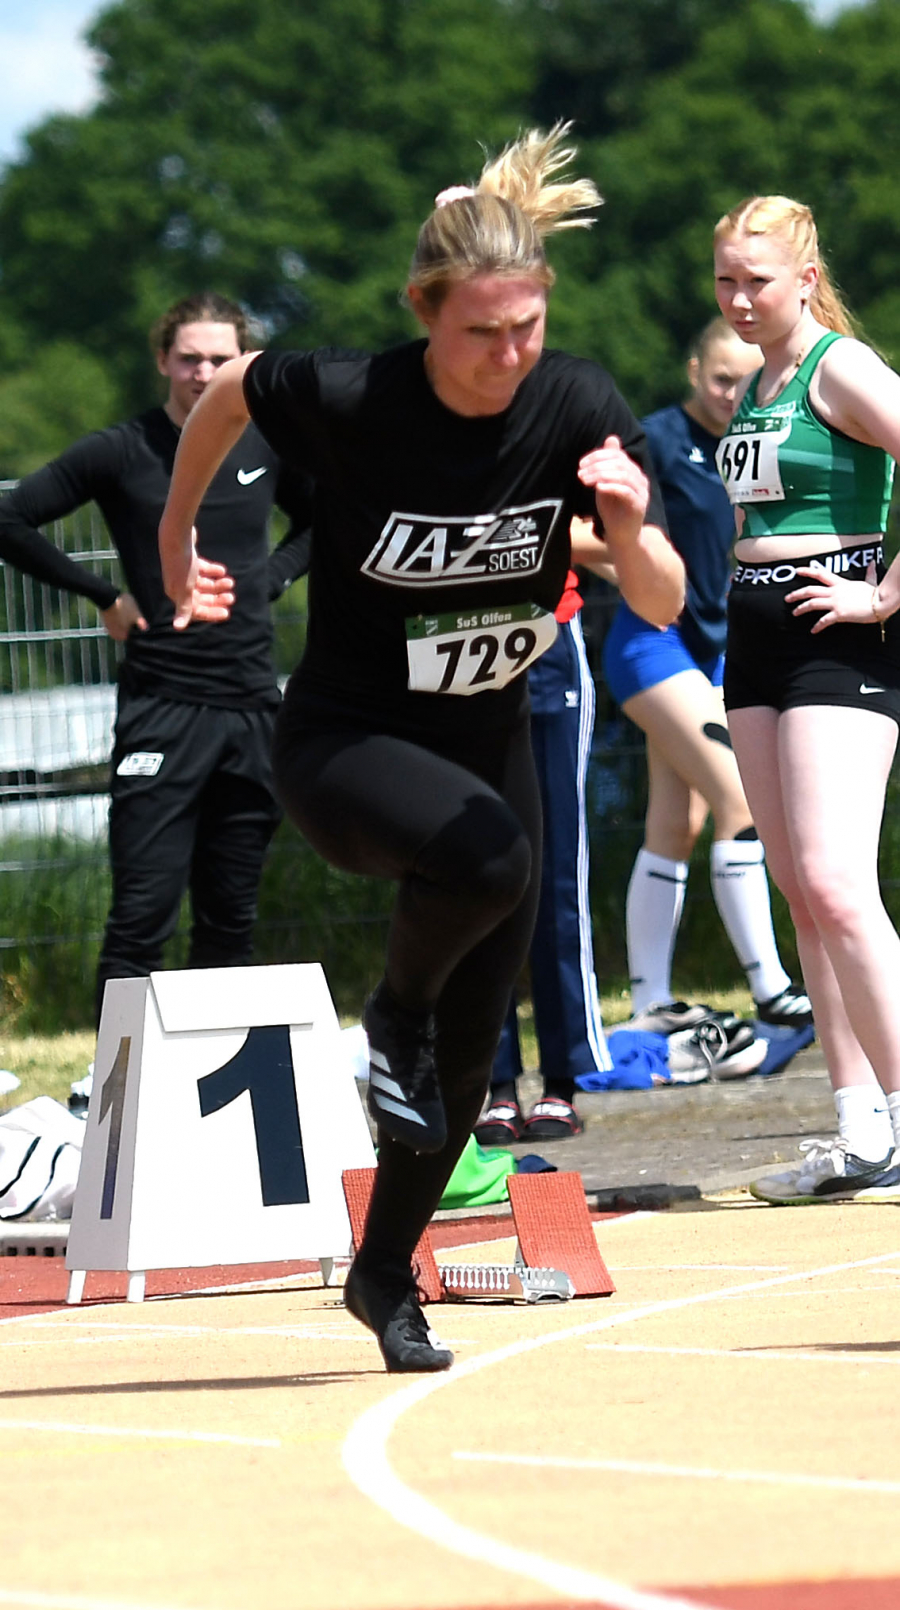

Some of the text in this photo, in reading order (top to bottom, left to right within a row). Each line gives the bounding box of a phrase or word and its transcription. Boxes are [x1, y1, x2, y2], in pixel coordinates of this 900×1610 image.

[722, 440, 761, 484] 691
[489, 547, 539, 573] SOEST
[457, 612, 512, 629] SuS Olfen
[436, 628, 537, 692] 729
[98, 1036, 131, 1219] 1
[196, 1024, 310, 1206] 1
